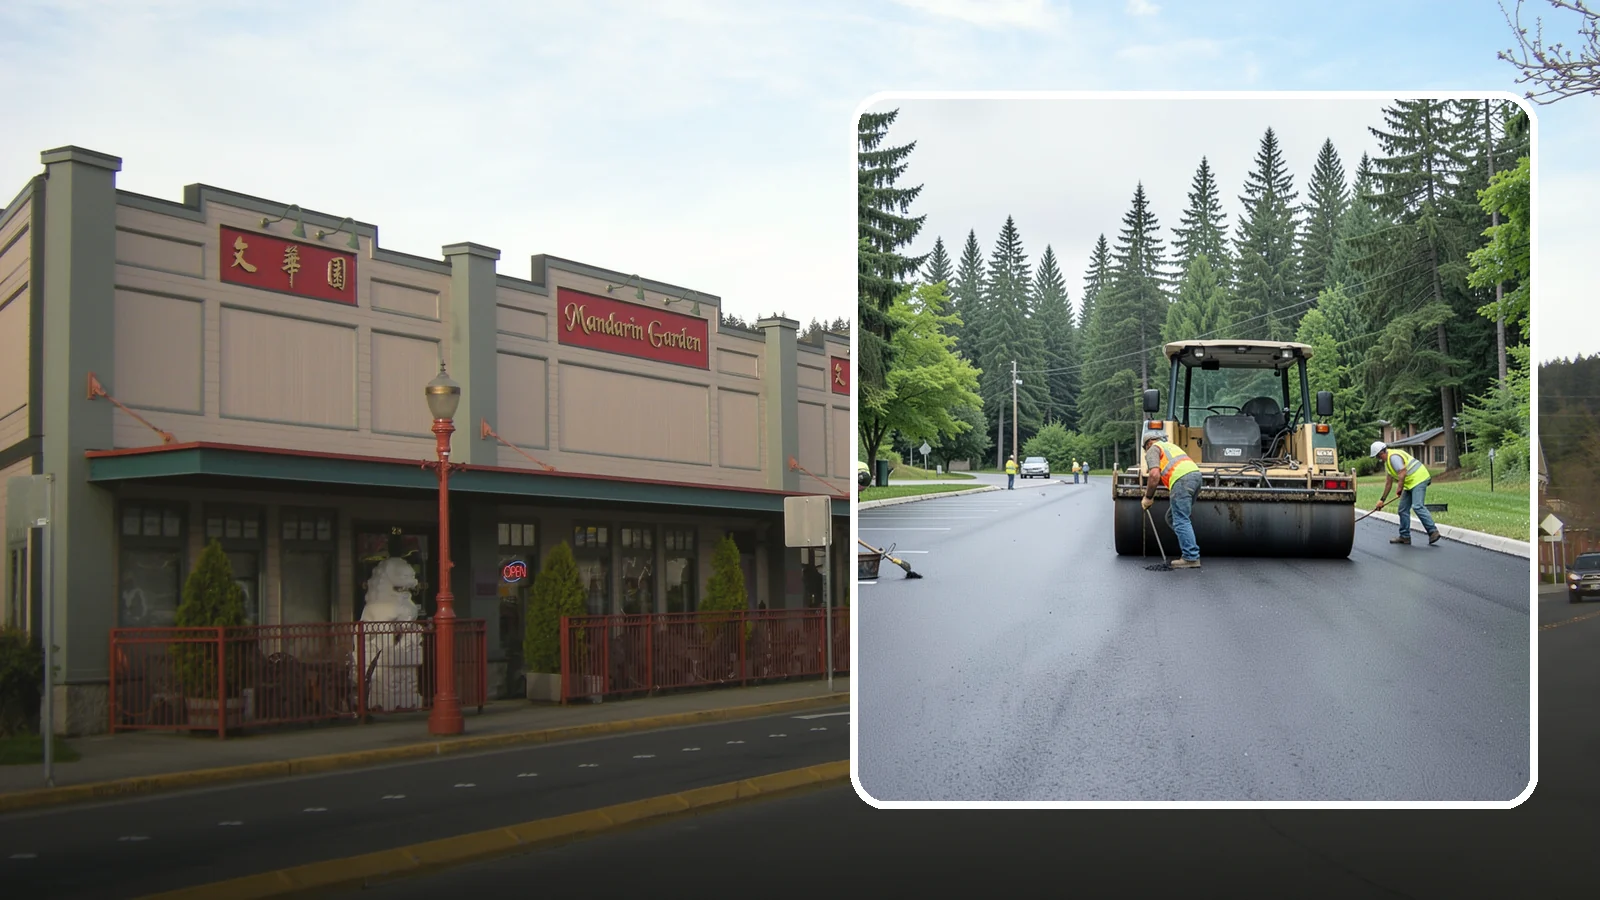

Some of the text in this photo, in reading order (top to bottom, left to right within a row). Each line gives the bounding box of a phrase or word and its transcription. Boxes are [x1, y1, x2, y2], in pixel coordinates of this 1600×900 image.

[231, 235, 346, 291] 文華園
[564, 302, 701, 352] Mandarin Garden
[503, 565, 527, 578] OPEN
